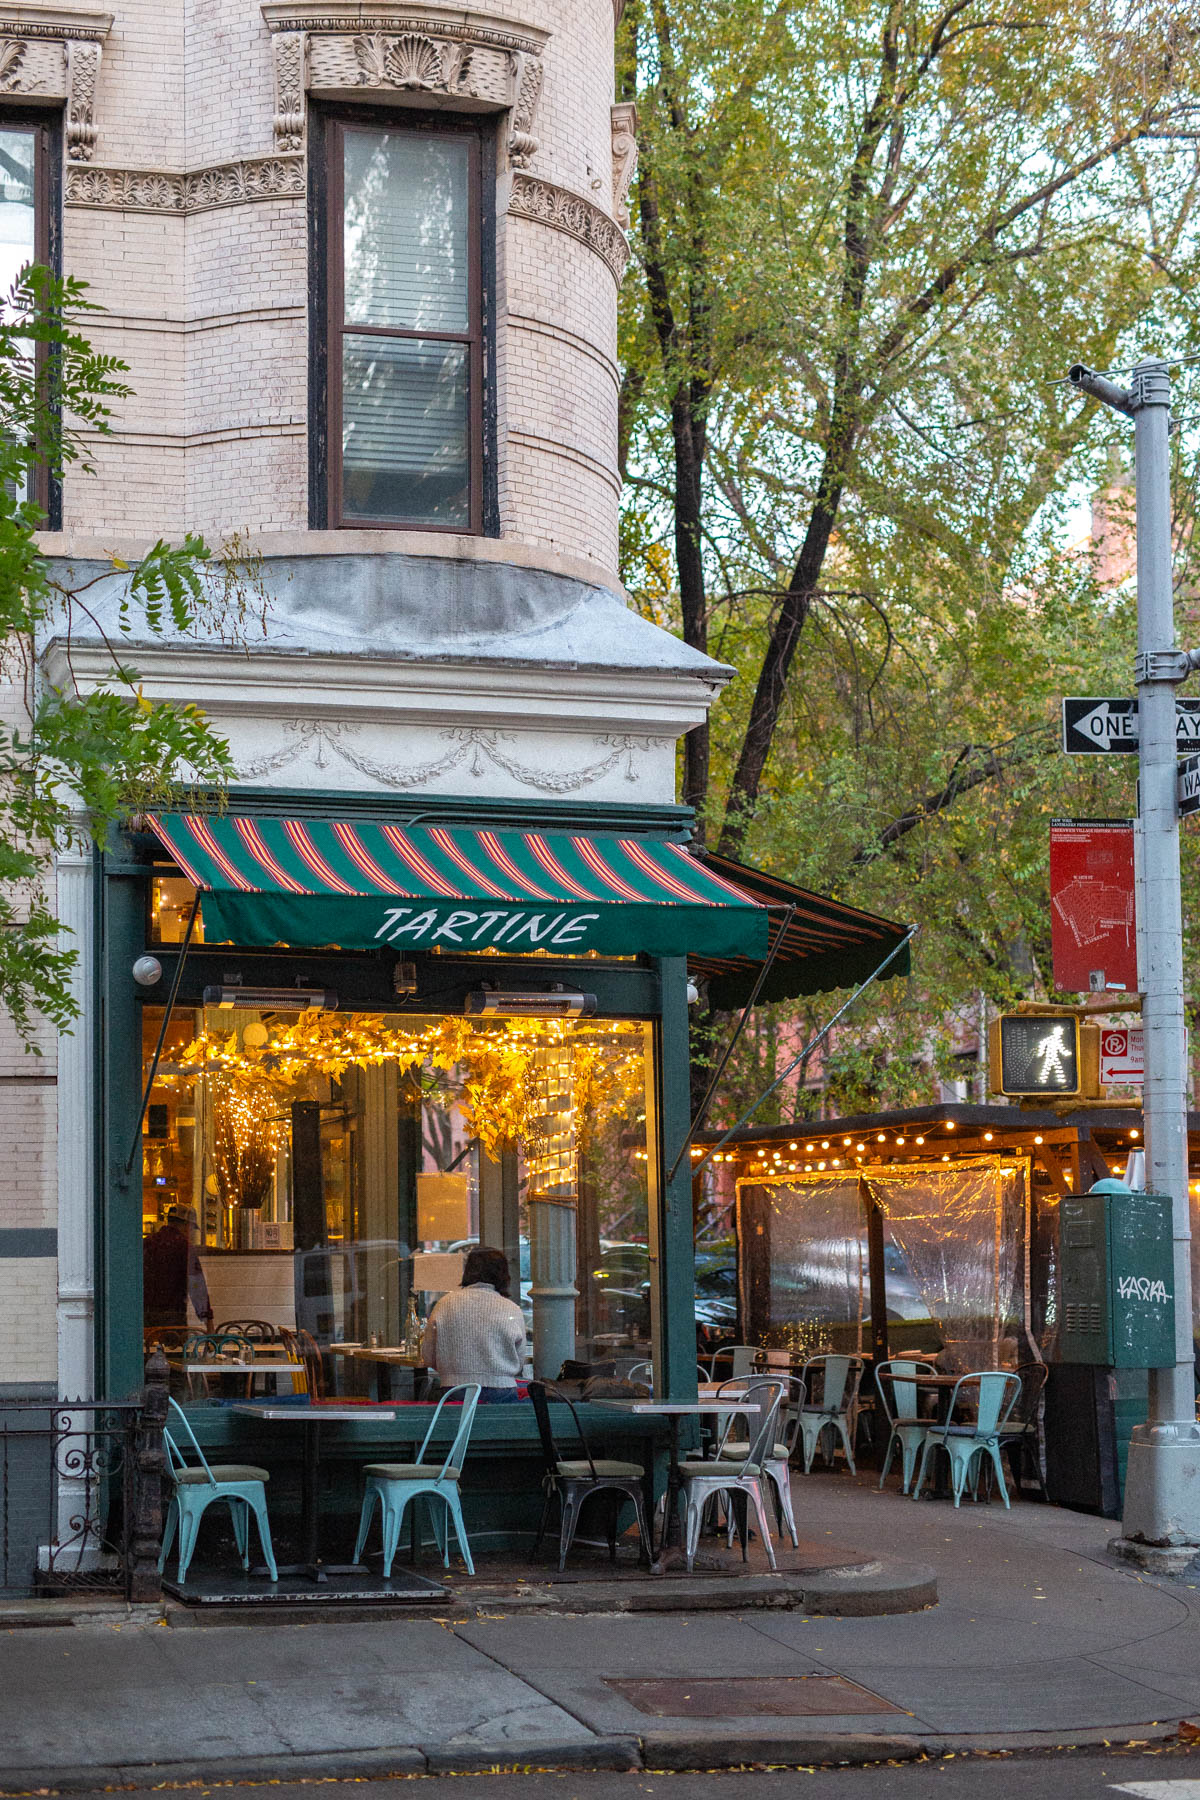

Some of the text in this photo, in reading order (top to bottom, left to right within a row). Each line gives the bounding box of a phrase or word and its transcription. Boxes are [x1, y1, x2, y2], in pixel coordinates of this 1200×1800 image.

[1091, 716, 1200, 736] ONE AY
[374, 908, 600, 944] TARTINE
